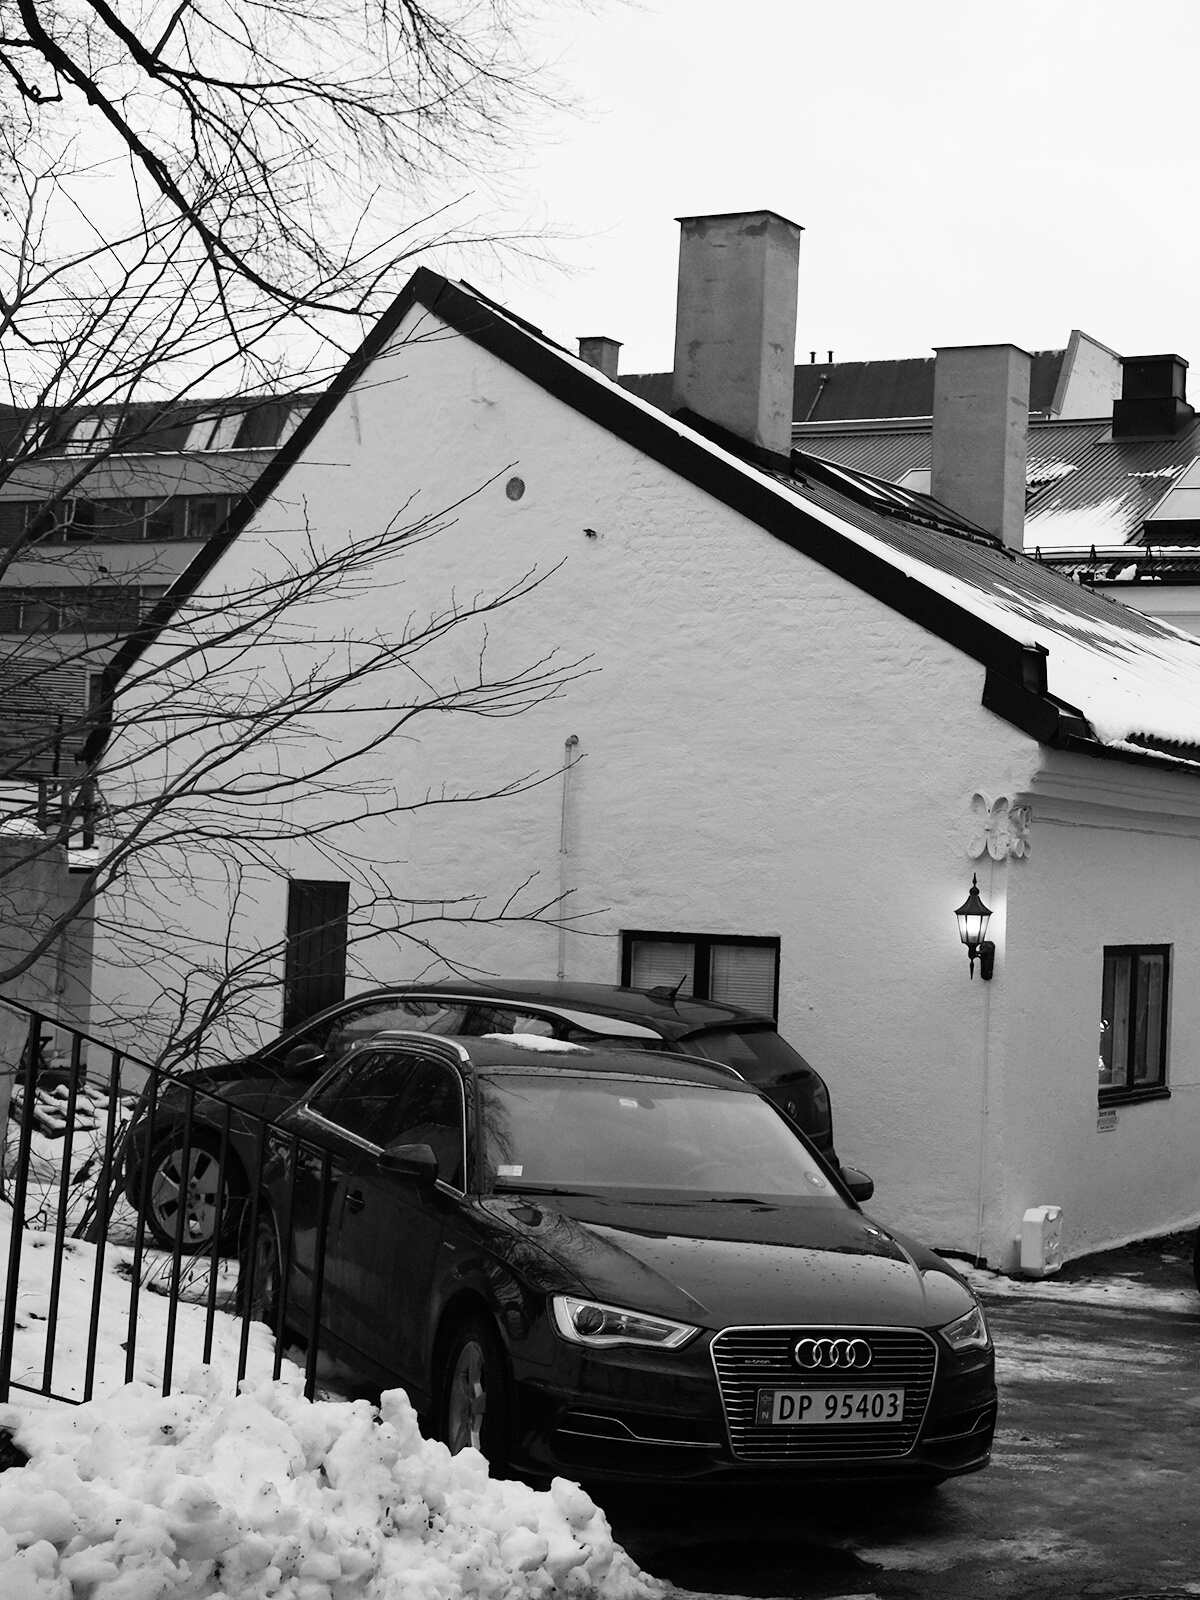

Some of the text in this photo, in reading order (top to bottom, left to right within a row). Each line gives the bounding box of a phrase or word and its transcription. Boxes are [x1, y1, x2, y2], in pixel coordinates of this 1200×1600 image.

[761, 1411, 770, 1419] N
[779, 1393, 899, 1420] DP 95403
